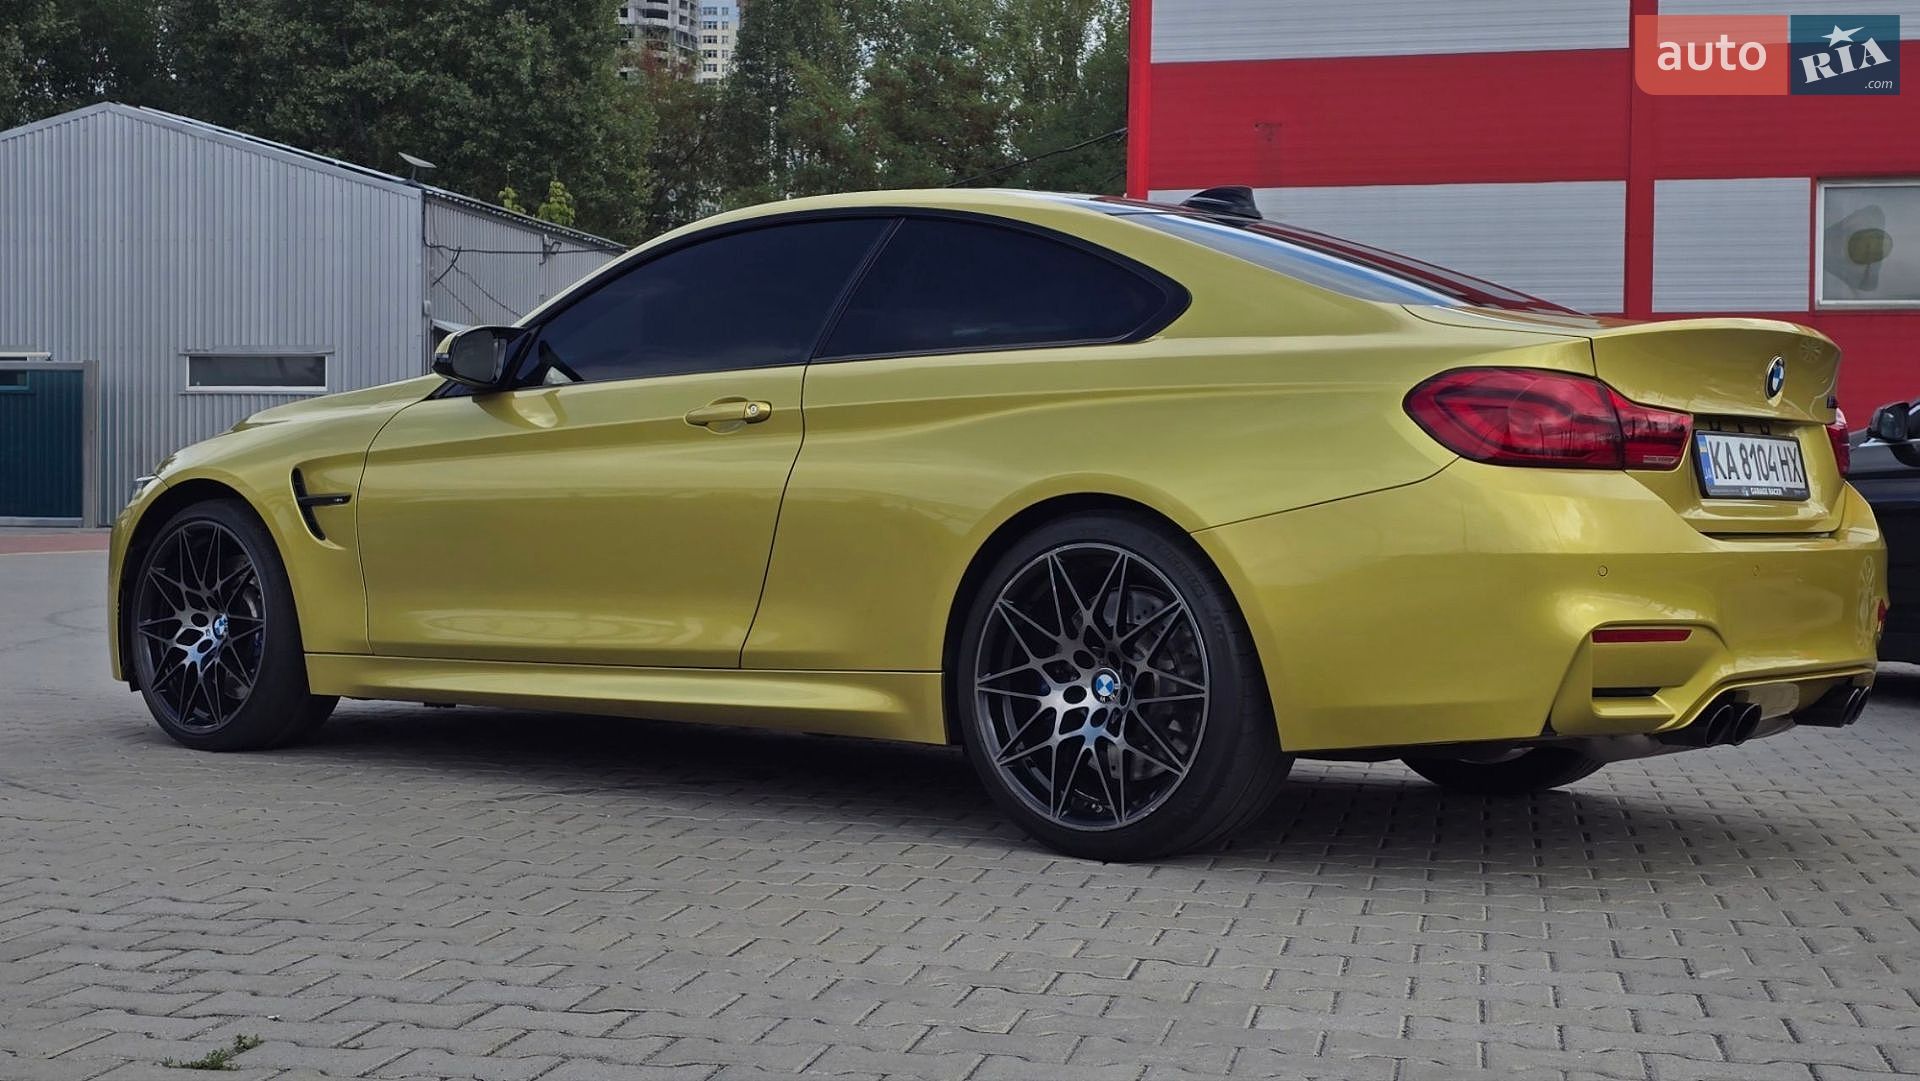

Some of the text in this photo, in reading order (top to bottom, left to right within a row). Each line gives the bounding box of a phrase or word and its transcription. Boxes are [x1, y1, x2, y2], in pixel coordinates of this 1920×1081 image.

[1709, 440, 1740, 480] KA
[1739, 443, 1779, 482] 8104
[1777, 445, 1802, 482] HX
